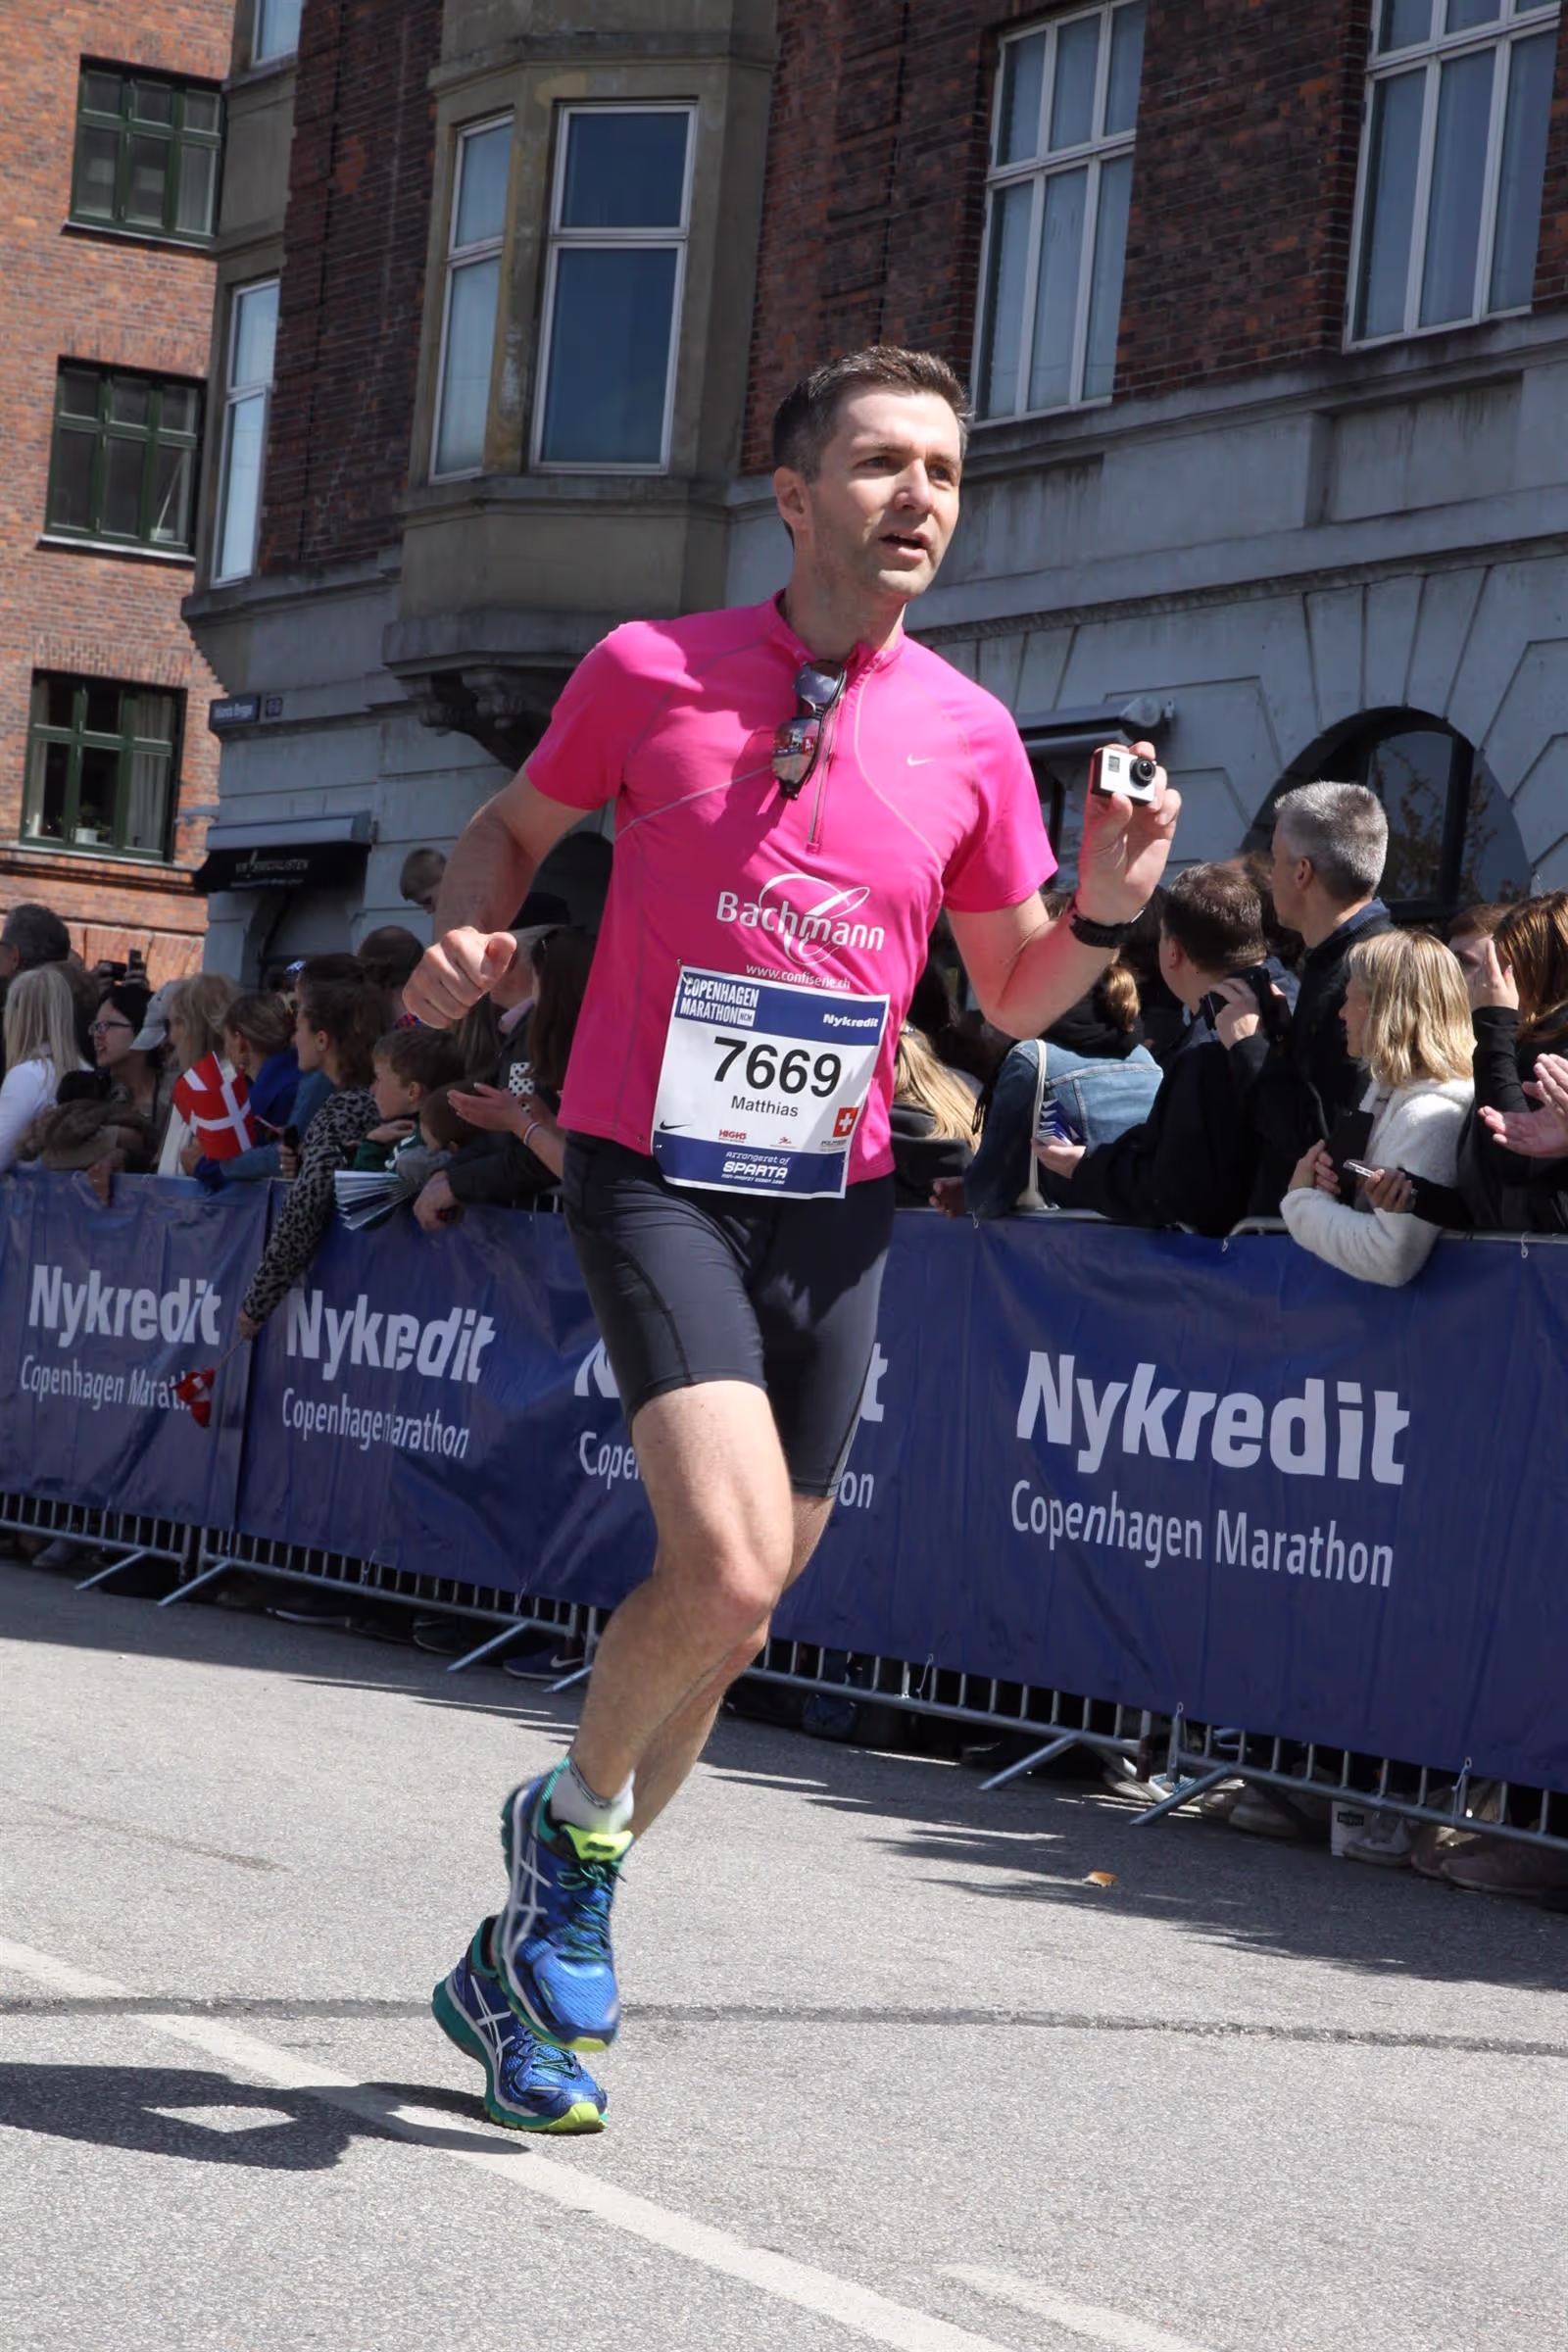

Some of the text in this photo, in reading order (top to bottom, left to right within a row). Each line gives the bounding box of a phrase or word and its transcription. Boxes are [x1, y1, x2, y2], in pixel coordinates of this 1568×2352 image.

[716, 891, 886, 953] Bachmann
[679, 997, 738, 1024] MARATHON
[683, 976, 760, 1008] COPENHAGEN
[823, 1013, 879, 1028] Nykredit
[713, 1036, 842, 1098] 7669
[731, 1095, 799, 1118] Matthias
[722, 1160, 789, 1180] SPARTA
[28, 1264, 221, 1348] Nykredit
[286, 1287, 496, 1384] Nykredit
[21, 1354, 124, 1411] Copenhagen
[282, 1387, 391, 1451] Copenhagen
[1016, 1350, 1410, 1486] Nykredit
[1011, 1479, 1394, 1588] Copenhagen Marathon
